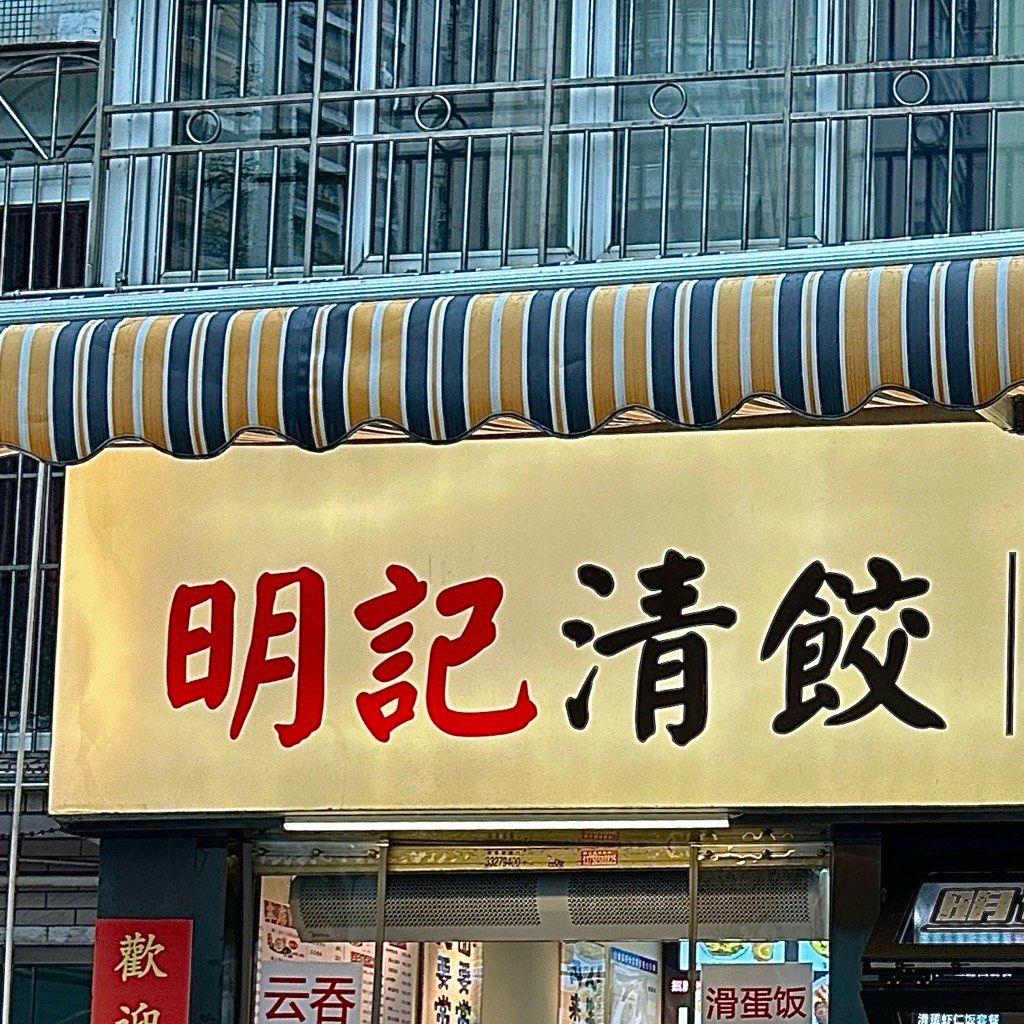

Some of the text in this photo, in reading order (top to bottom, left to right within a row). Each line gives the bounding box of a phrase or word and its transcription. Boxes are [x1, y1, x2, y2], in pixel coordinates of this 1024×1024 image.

[166, 548, 947, 748] 明記清餃
[264, 977, 356, 1024] 云吞
[706, 986, 807, 1020] 滑蛋饭
